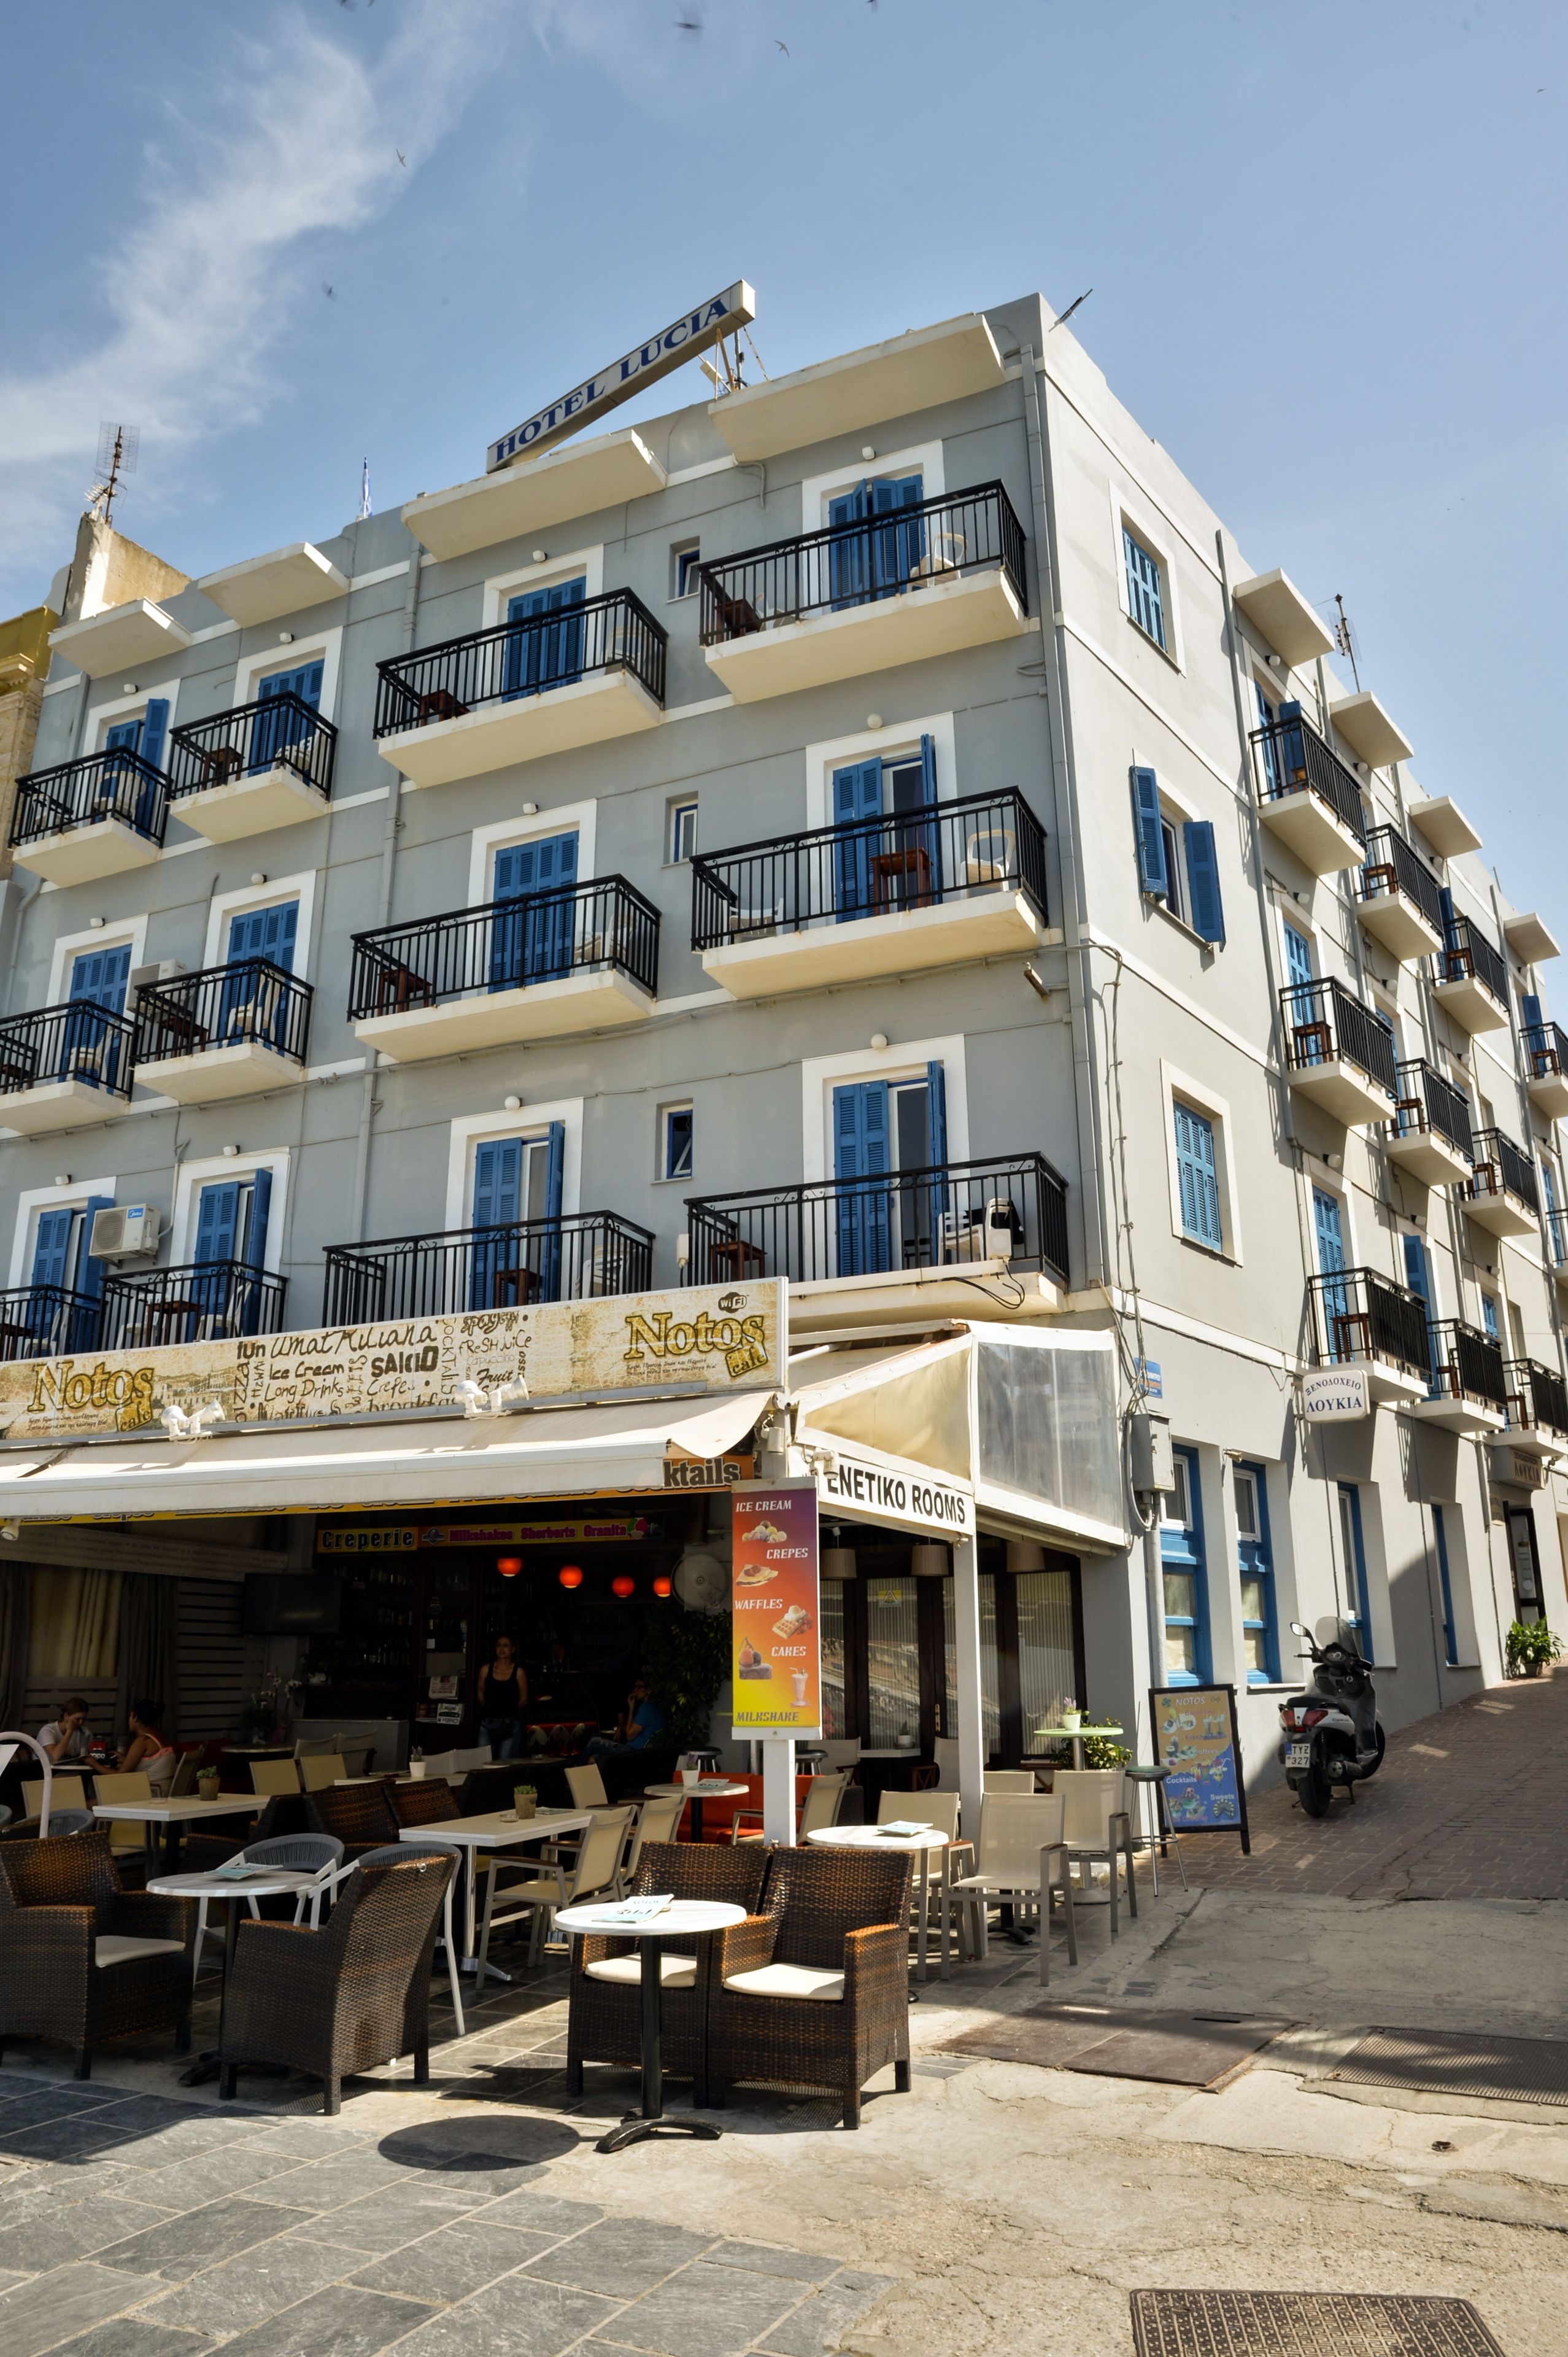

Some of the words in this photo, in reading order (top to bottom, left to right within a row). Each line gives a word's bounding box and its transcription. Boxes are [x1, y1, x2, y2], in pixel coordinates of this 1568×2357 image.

[496, 381, 605, 463] HOTEL
[619, 298, 729, 382] LUCIA
[624, 1311, 765, 1360] Notos
[27, 1361, 155, 1412] Notos
[264, 1383, 298, 1404] Long
[301, 1377, 344, 1399] Drinks
[1305, 1377, 1361, 1396] ΞΕΝΟΔΟΧΕΙΟ
[1306, 1396, 1362, 1413] ΛΟΥΚΙΑ
[644, 1457, 741, 1490] ktails
[736, 1501, 754, 1512] ICE
[755, 1500, 792, 1511] CREAM
[912, 1484, 966, 1525] ROOMS
[322, 1528, 414, 1552] Creperie
[766, 1547, 809, 1559] CREPES
[734, 1598, 783, 1610] WAFFLES
[771, 1646, 806, 1657] CAKES
[1175, 1696, 1206, 1706] NOTOS
[736, 1711, 800, 1722] MILKSHAKE
[1292, 1745, 1310, 1754] TYZ
